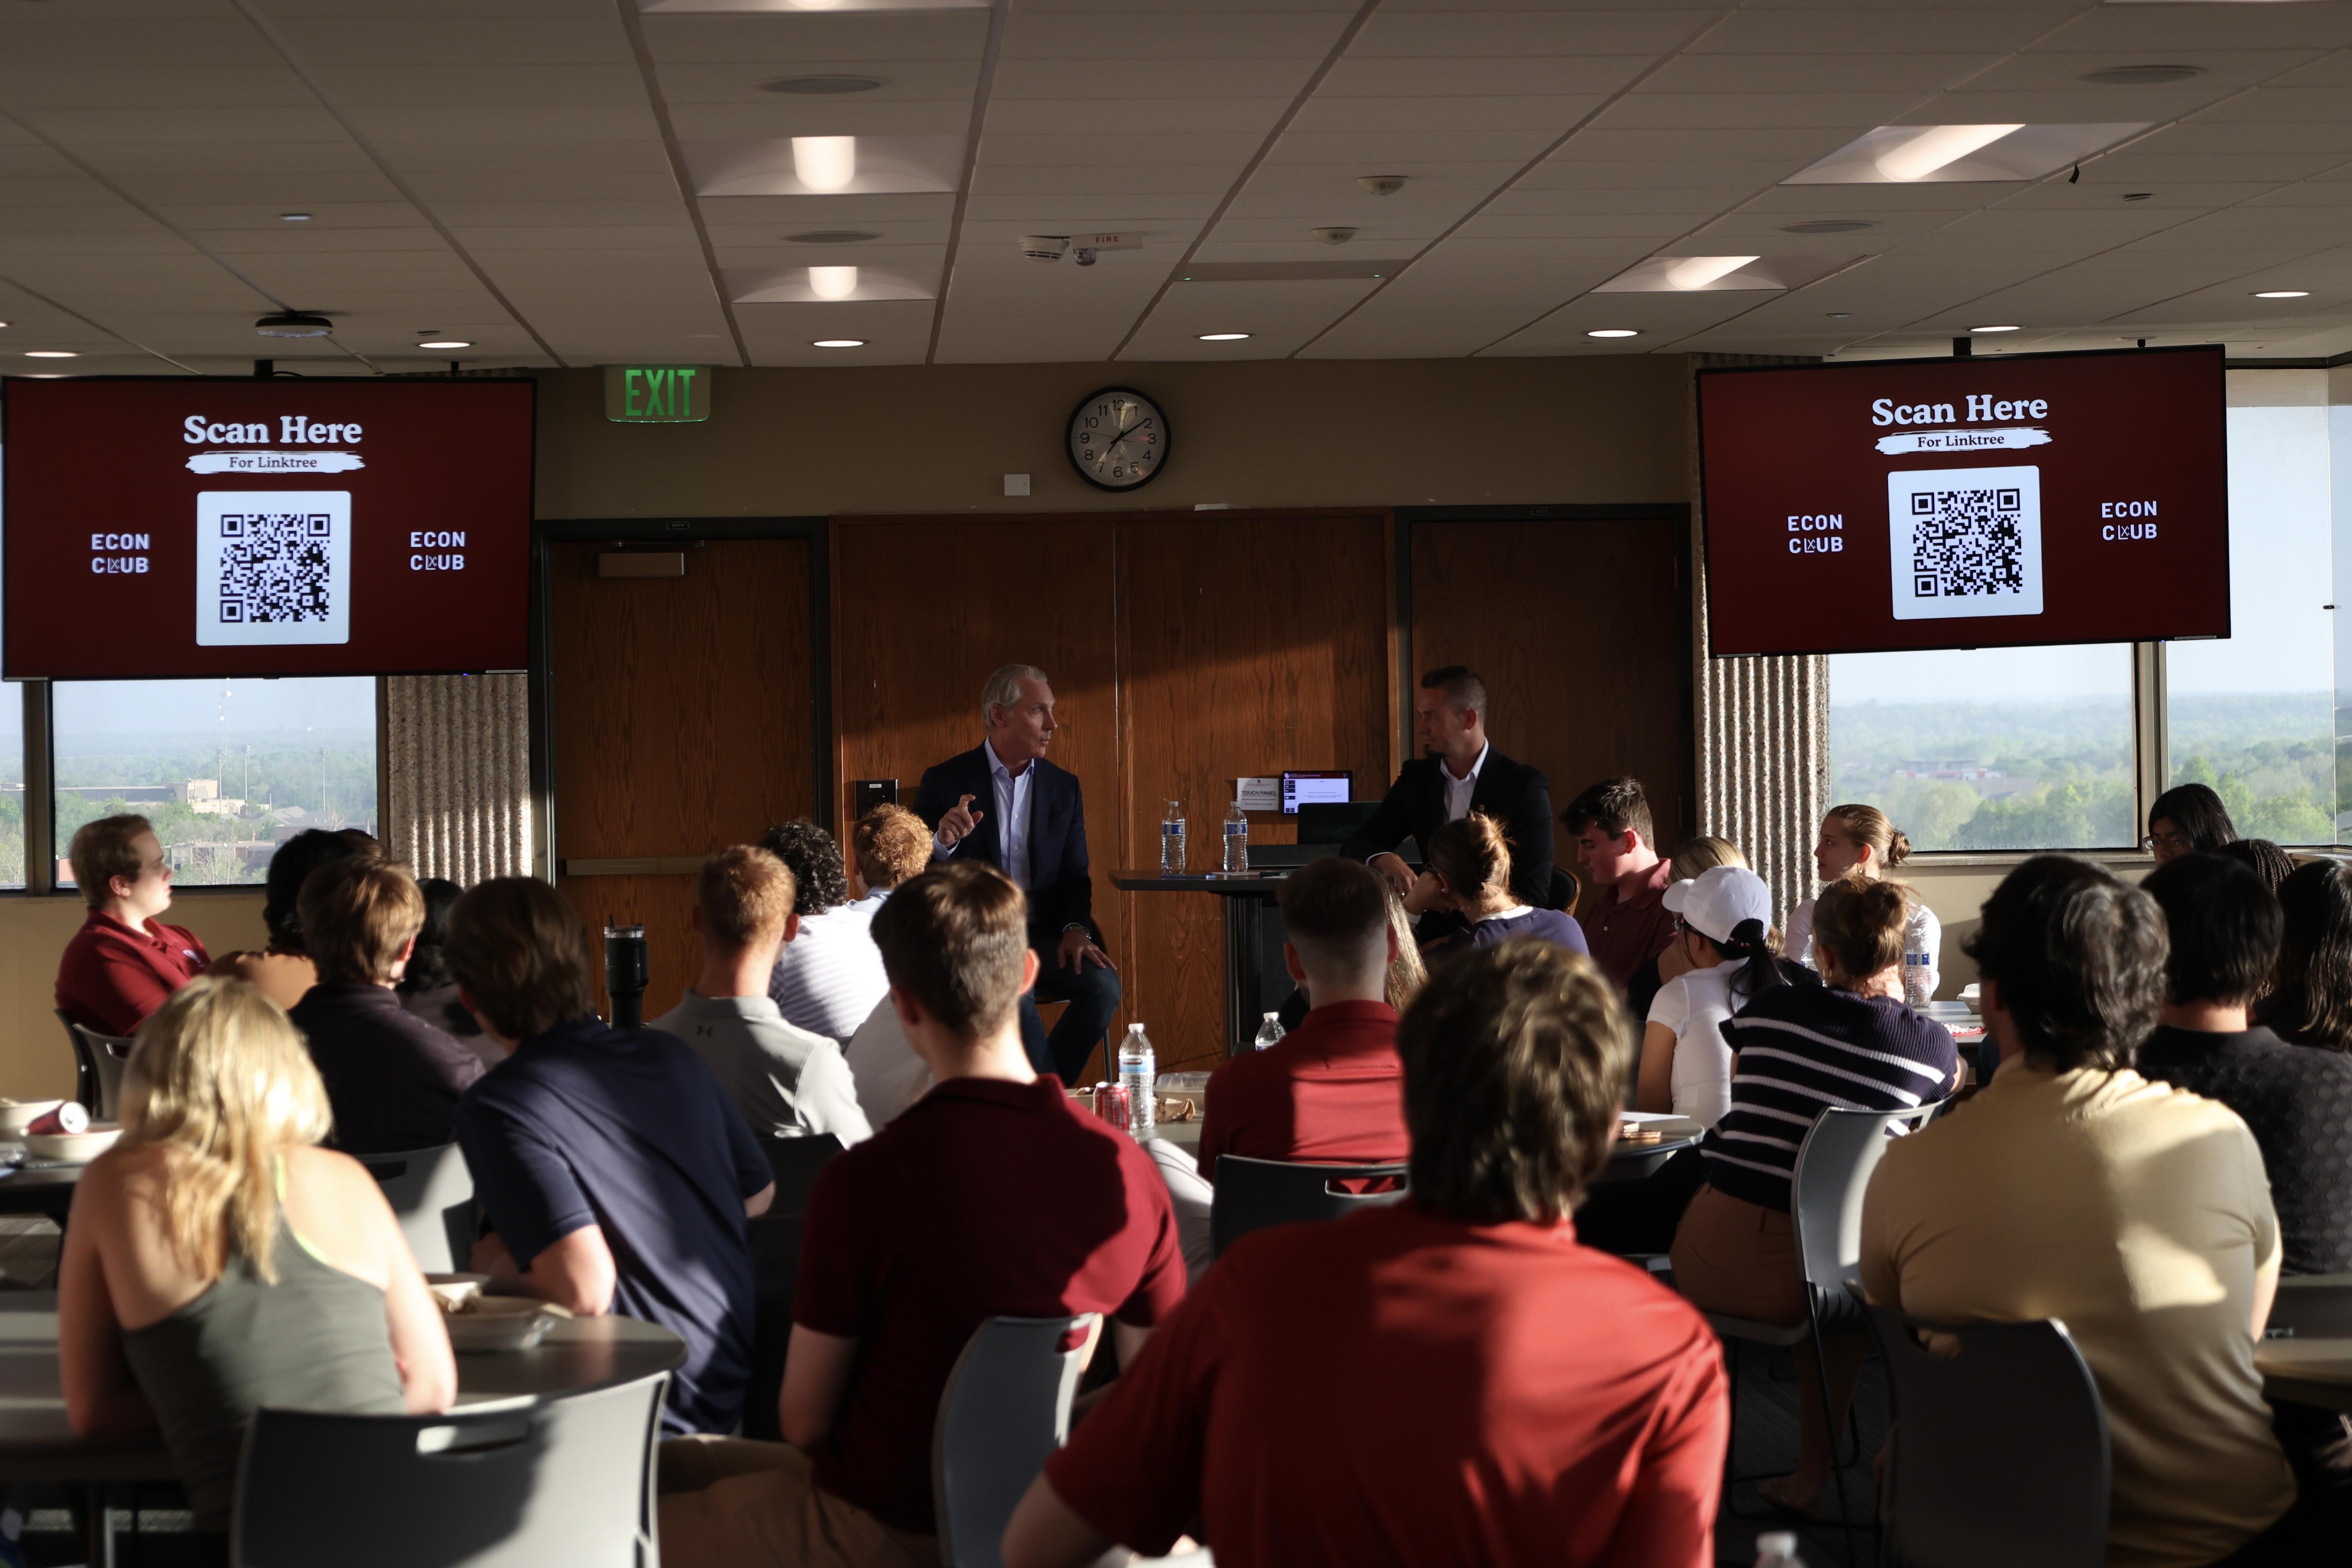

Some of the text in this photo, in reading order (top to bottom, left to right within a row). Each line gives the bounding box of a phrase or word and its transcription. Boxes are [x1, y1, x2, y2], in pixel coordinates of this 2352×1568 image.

[625, 370, 695, 416] EXIT
[1098, 405, 1107, 416] 11
[1112, 400, 1125, 410] 12
[1133, 406, 1138, 416] 1
[1872, 394, 2048, 426] Scan Here
[1084, 417, 1099, 428] 10
[1143, 418, 1152, 429] 2
[184, 416, 362, 444] Scan Here
[1080, 432, 1090, 444] 9
[1147, 433, 1156, 444] 3
[1917, 434, 2005, 447] For Linktree
[1084, 450, 1093, 460] 8
[1142, 450, 1152, 461] 4
[229, 456, 317, 468] For Linktree
[1098, 462, 1105, 473] 7
[1130, 462, 1139, 473] 5
[1113, 467, 1123, 478] 6
[2101, 501, 2157, 518] ECON
[1788, 514, 1843, 531] ECON
[2102, 524, 2157, 540] CLUB
[92, 534, 150, 550] ECON
[410, 532, 465, 547] ECON
[1789, 537, 1843, 554] CLUB
[92, 557, 150, 573] CLUB
[410, 555, 465, 570] CLUB
